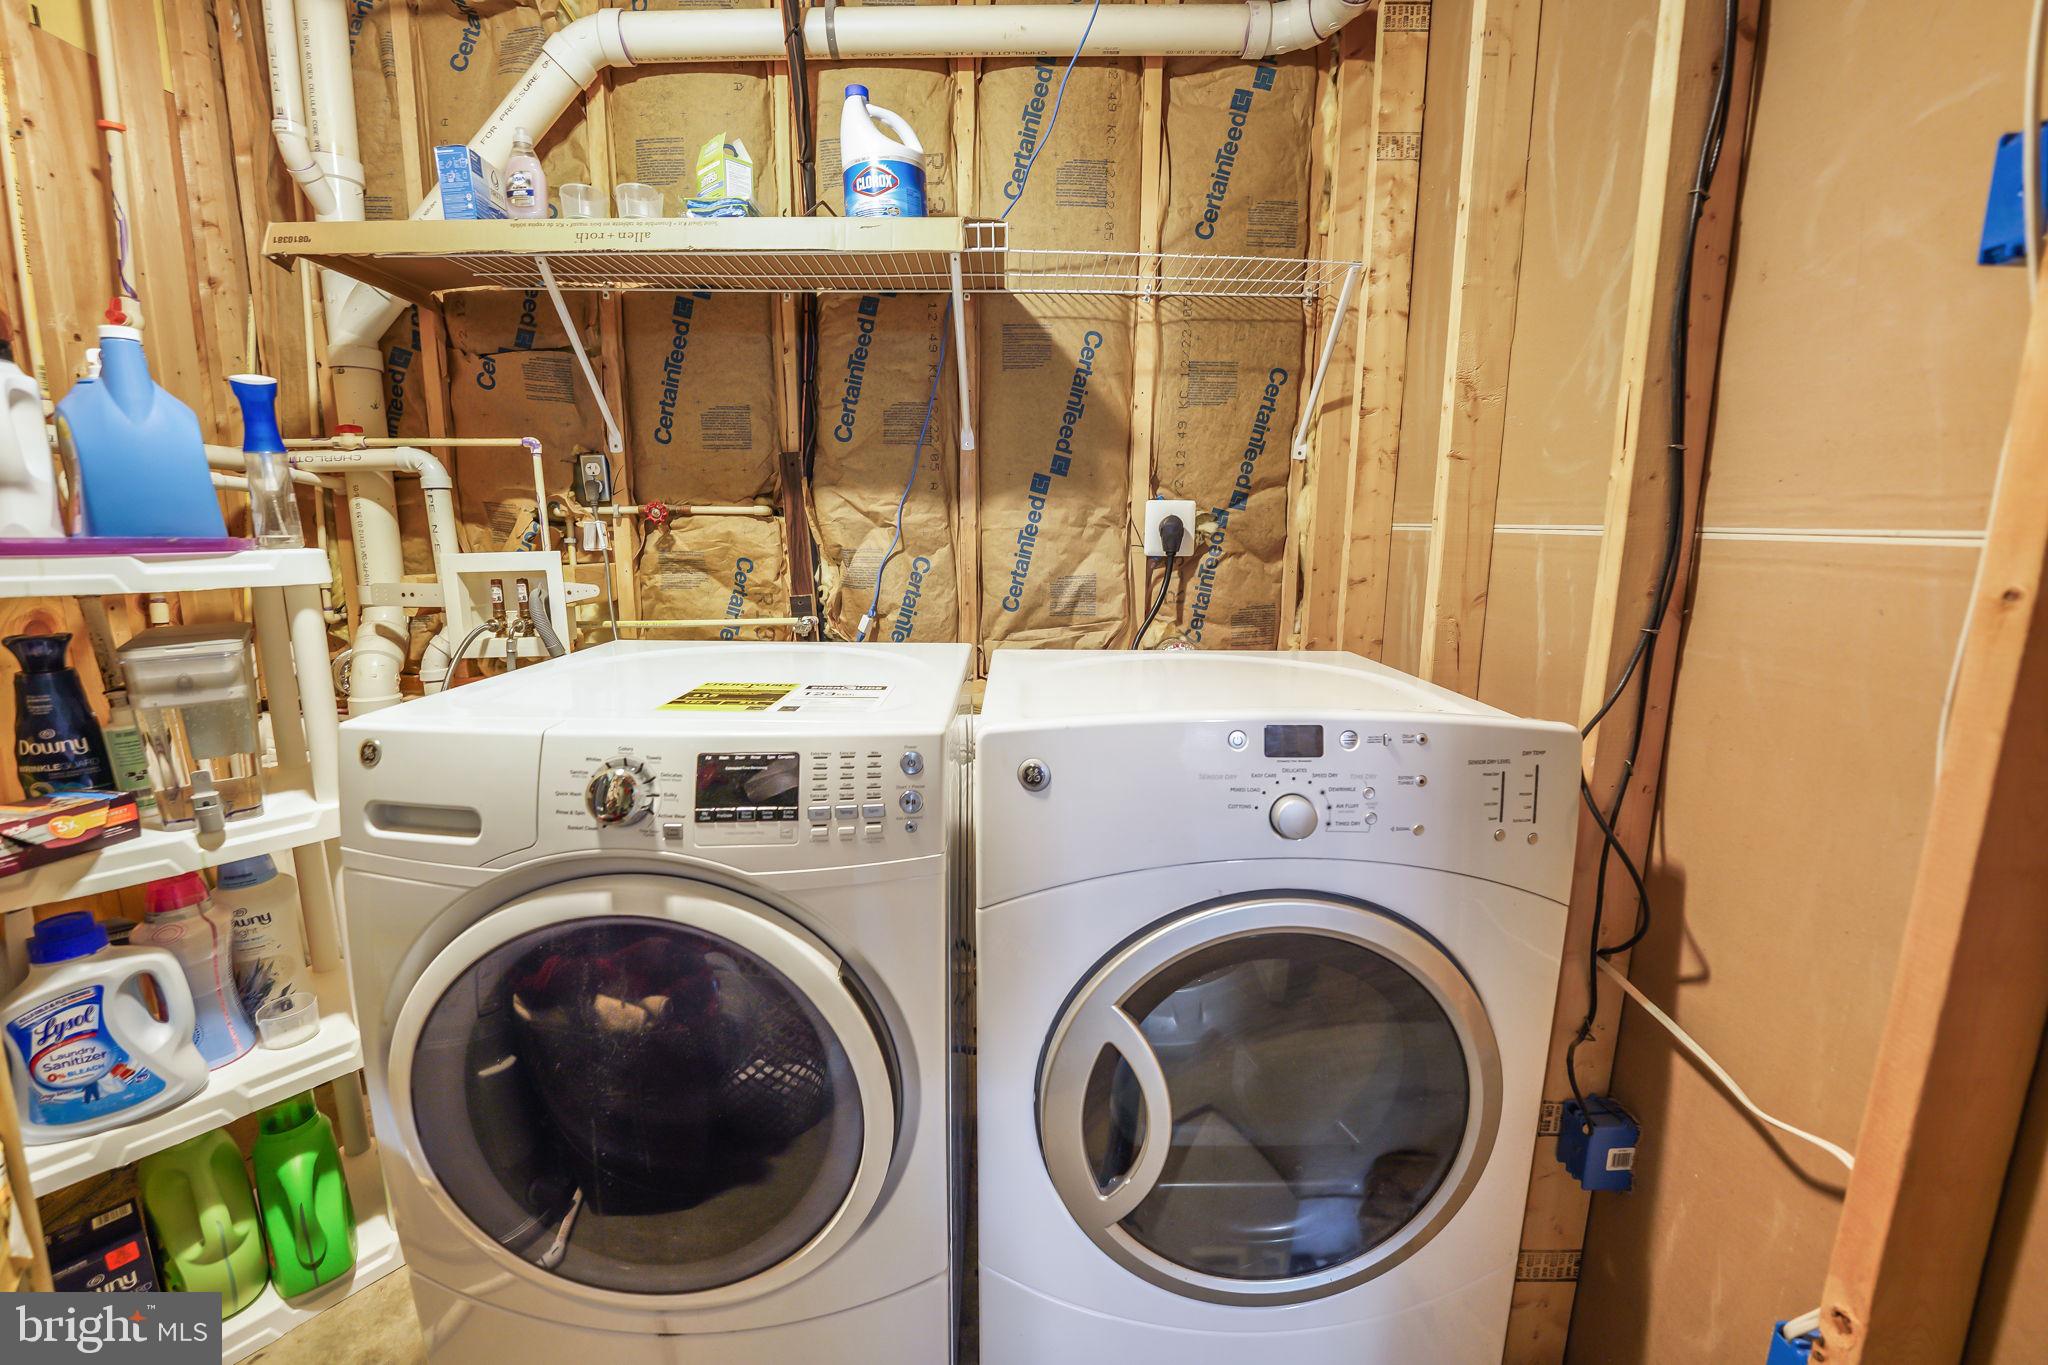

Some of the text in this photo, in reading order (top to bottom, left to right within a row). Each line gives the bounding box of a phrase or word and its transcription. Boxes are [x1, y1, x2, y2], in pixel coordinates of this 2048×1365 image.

[480, 125, 498, 145] FOR
[499, 73, 540, 122] PRESSURE
[1002, 66, 1054, 200] CertainTeed
[855, 174, 893, 191] CLOROX
[1195, 112, 1247, 240] CertainTeed
[575, 232, 605, 243] roth
[618, 231, 651, 242] allen
[654, 319, 690, 445] CertainTeed
[834, 317, 875, 443] CertainTeed
[1055, 330, 1103, 455] CertainTeed
[1178, 390, 1190, 409] KC
[1235, 367, 1289, 493] CertainTeed
[288, 455, 362, 464] CHARLOTT
[1002, 495, 1046, 613] CertainTeed
[891, 556, 931, 643] CertainTe
[20, 737, 89, 756] Downy
[232, 911, 272, 928] owny
[34, 1005, 95, 1046] Lysol
[43, 1050, 107, 1072] Sanitizer
[50, 1046, 97, 1062] Laundry
[47, 1064, 105, 1082] 0% BLEACH
